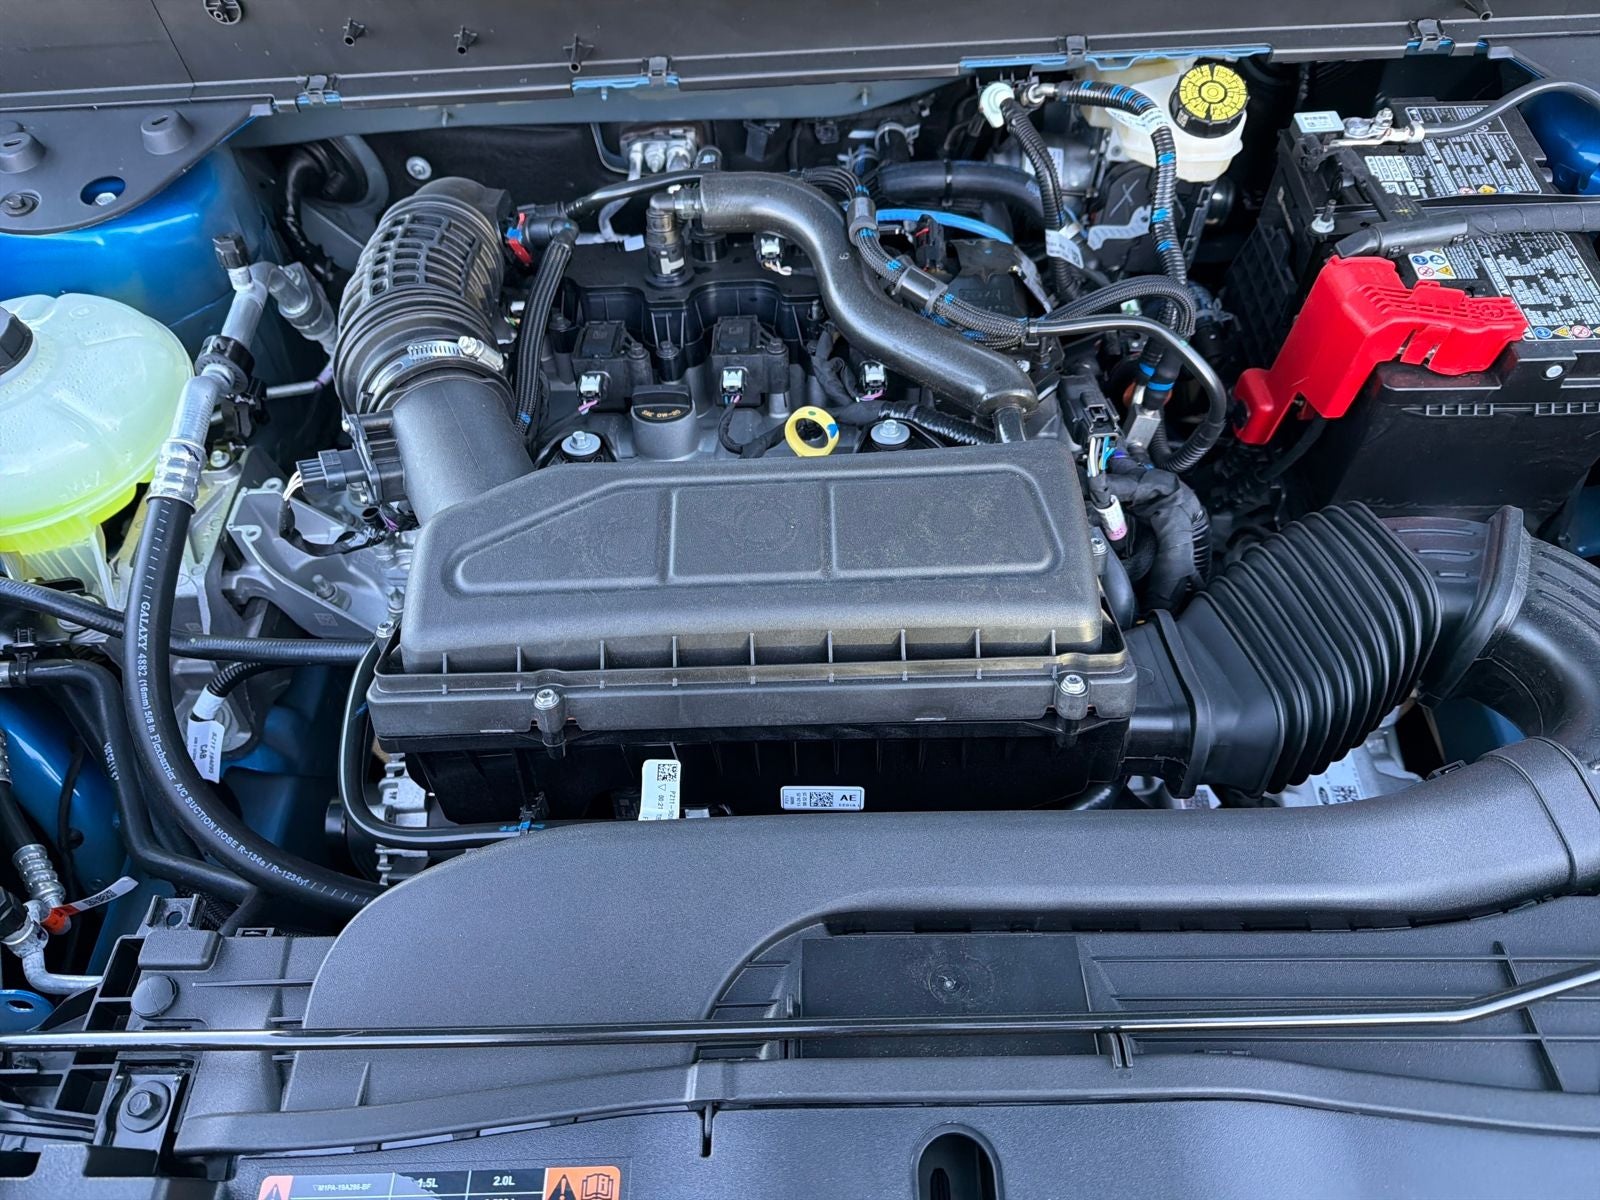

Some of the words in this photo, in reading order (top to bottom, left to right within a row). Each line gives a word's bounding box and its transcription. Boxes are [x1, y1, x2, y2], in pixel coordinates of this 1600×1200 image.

[138, 601, 151, 650] GALAXY
[138, 653, 148, 676] 4882
[138, 678, 151, 710] (16mm)
[144, 711, 154, 724] 5/8
[149, 734, 177, 781] Flexbarrier
[199, 744, 208, 760] CAB
[173, 781, 188, 798] A/C
[184, 795, 217, 831] SUCTION
[214, 827, 238, 849] HOSE
[237, 844, 267, 868] R-134a
[271, 865, 309, 887] R-1234yf
[493, 1176, 515, 1186] 2.0L
